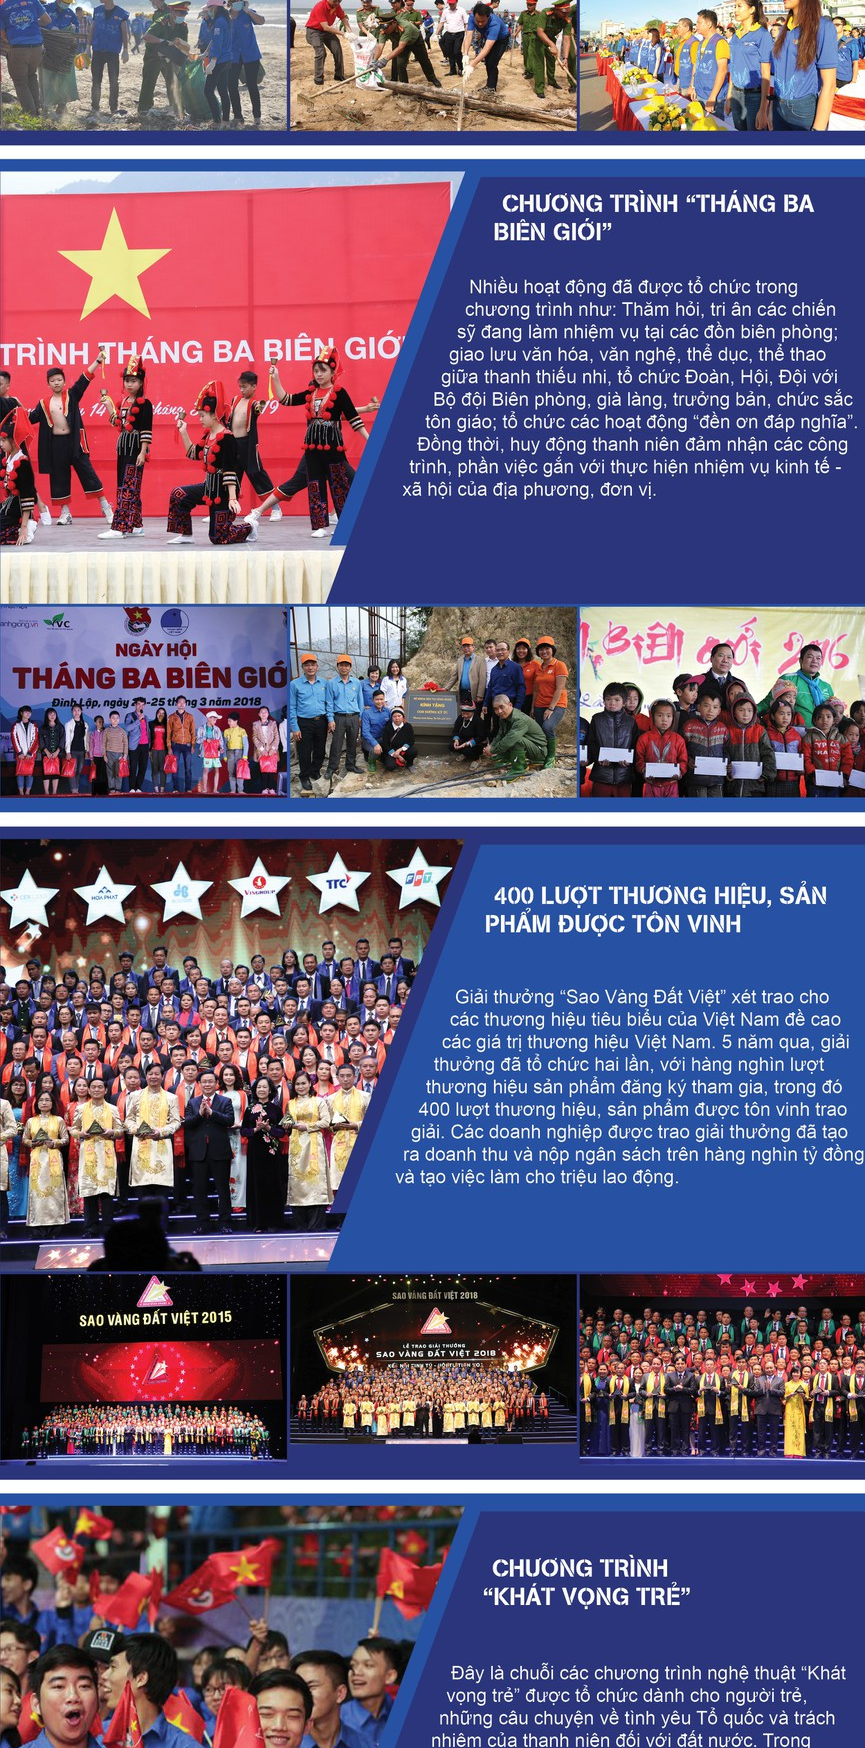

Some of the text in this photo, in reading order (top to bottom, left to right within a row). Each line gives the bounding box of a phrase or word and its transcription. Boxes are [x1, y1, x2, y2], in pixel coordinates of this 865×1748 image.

[0, 335, 255, 366] TRÌNH THÁNG BA
[116, 640, 197, 660] NGÀY HỘI
[12, 660, 232, 689] THÁNG BA BIÊN
[326, 878, 347, 890] TTC
[405, 870, 432, 886] FPT
[79, 1308, 232, 1328] SAO VÀNG ĐẤT VIỆT 2015
